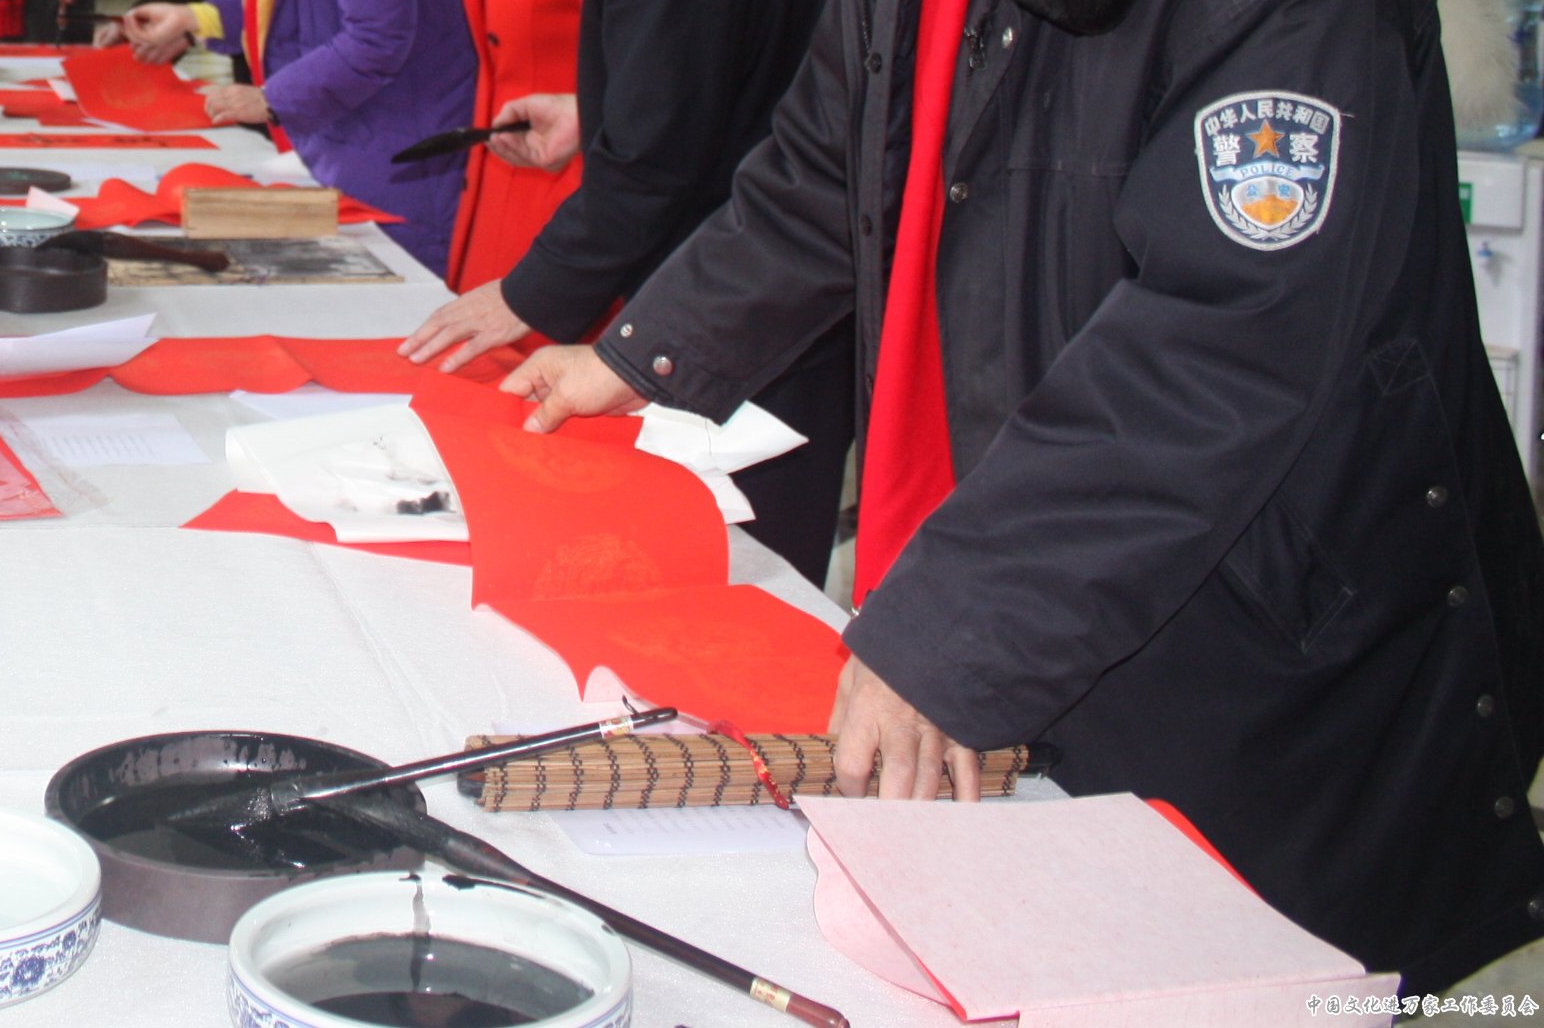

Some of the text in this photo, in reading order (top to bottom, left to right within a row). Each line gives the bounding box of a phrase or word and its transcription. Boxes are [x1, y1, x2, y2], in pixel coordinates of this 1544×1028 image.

[1204, 99, 1330, 136] 中华人民共和国
[1241, 162, 1294, 178] POLICE
